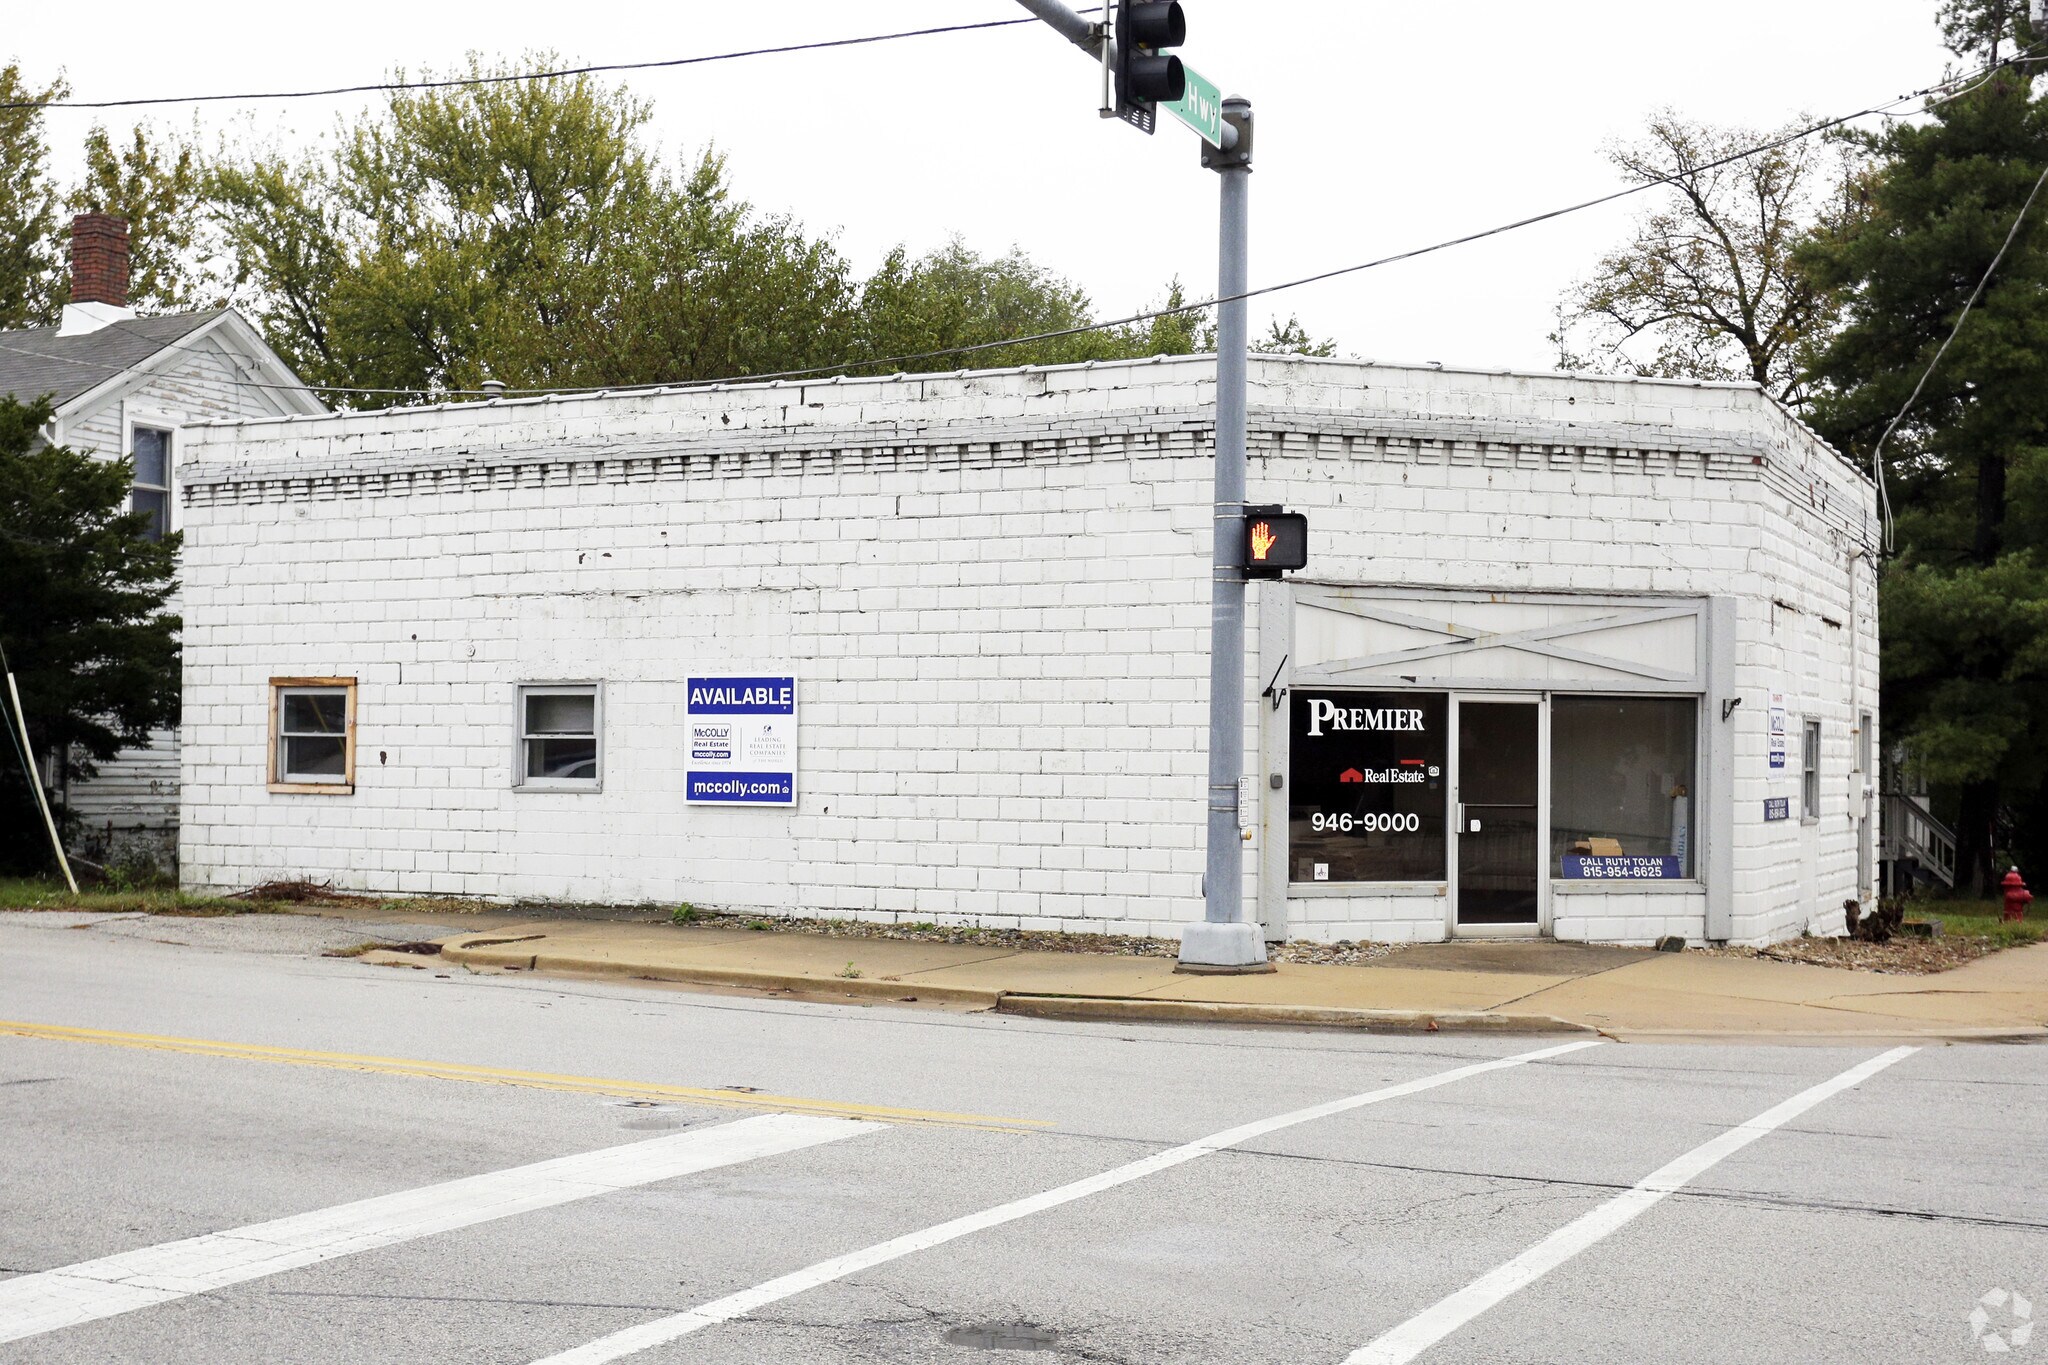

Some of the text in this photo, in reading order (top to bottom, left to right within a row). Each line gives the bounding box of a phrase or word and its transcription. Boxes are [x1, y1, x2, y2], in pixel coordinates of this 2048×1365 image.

[1188, 81, 1217, 134] Hwy
[690, 688, 791, 705] AVAILABLE
[1307, 699, 1425, 736] PREMIER
[694, 728, 729, 738] McCOLLY
[1364, 768, 1425, 783] Real Estate
[694, 780, 780, 797] mccolly.com
[1312, 813, 1420, 832] 946-9000
[1580, 858, 1663, 867] CALL RUTH TOLAN
[1583, 867, 1662, 877] 815-954-6625
